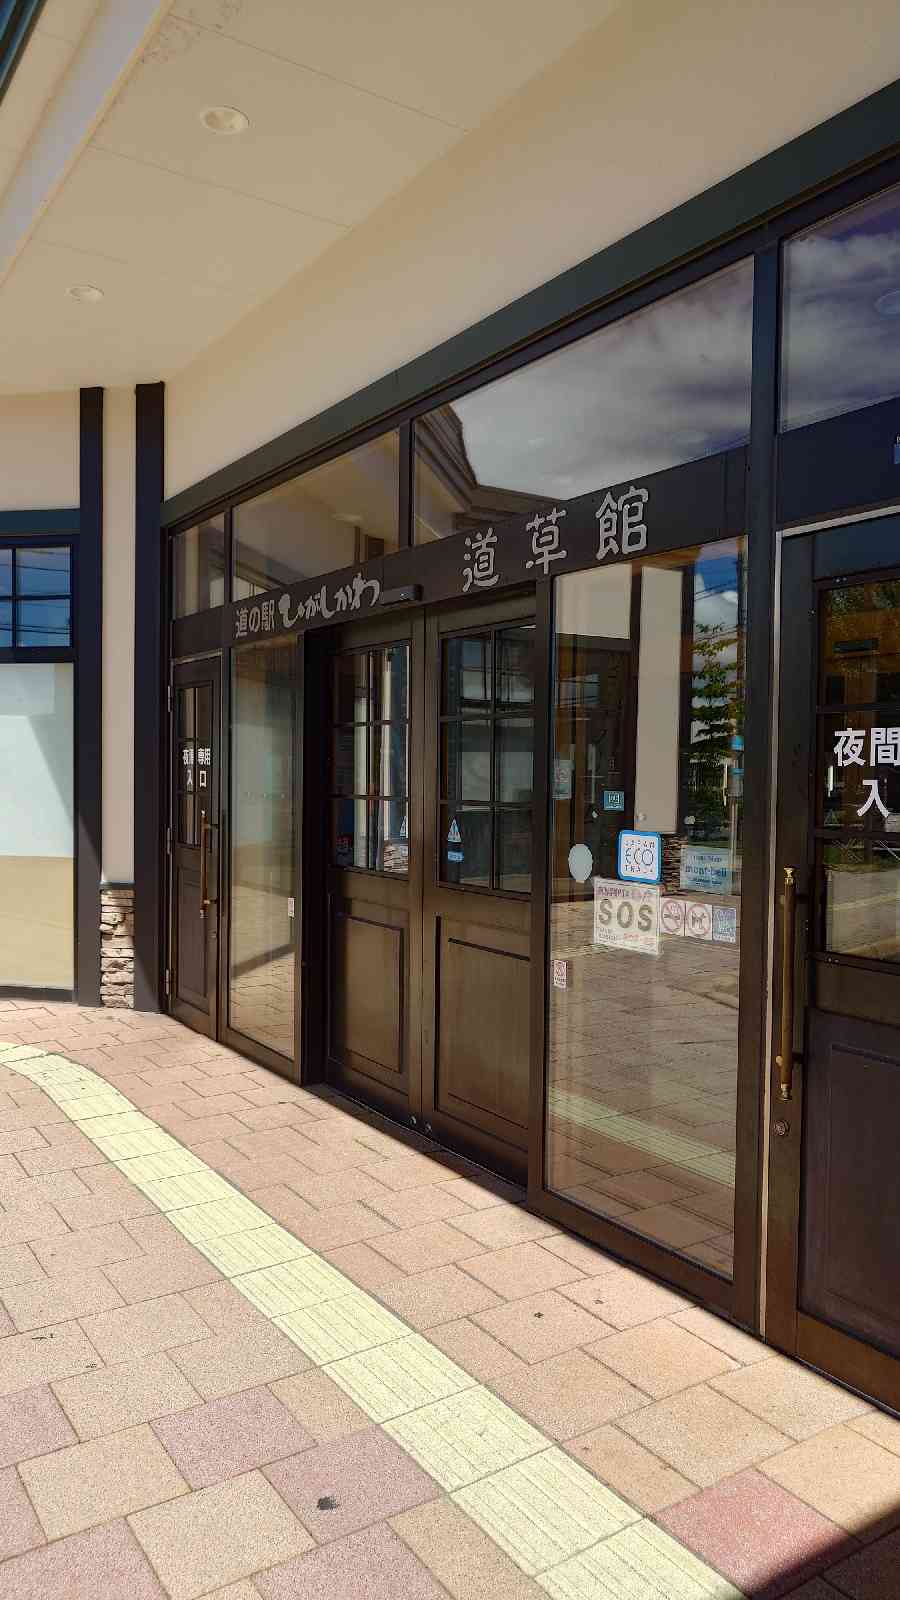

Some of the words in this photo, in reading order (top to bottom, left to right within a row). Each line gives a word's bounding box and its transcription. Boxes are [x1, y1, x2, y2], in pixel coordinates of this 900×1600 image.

[236, 599, 275, 638] 道の駅
[461, 485, 650, 592] 道草館
[857, 779, 890, 818] 入
[625, 847, 654, 866] ECO
[598, 898, 653, 932] SOS
